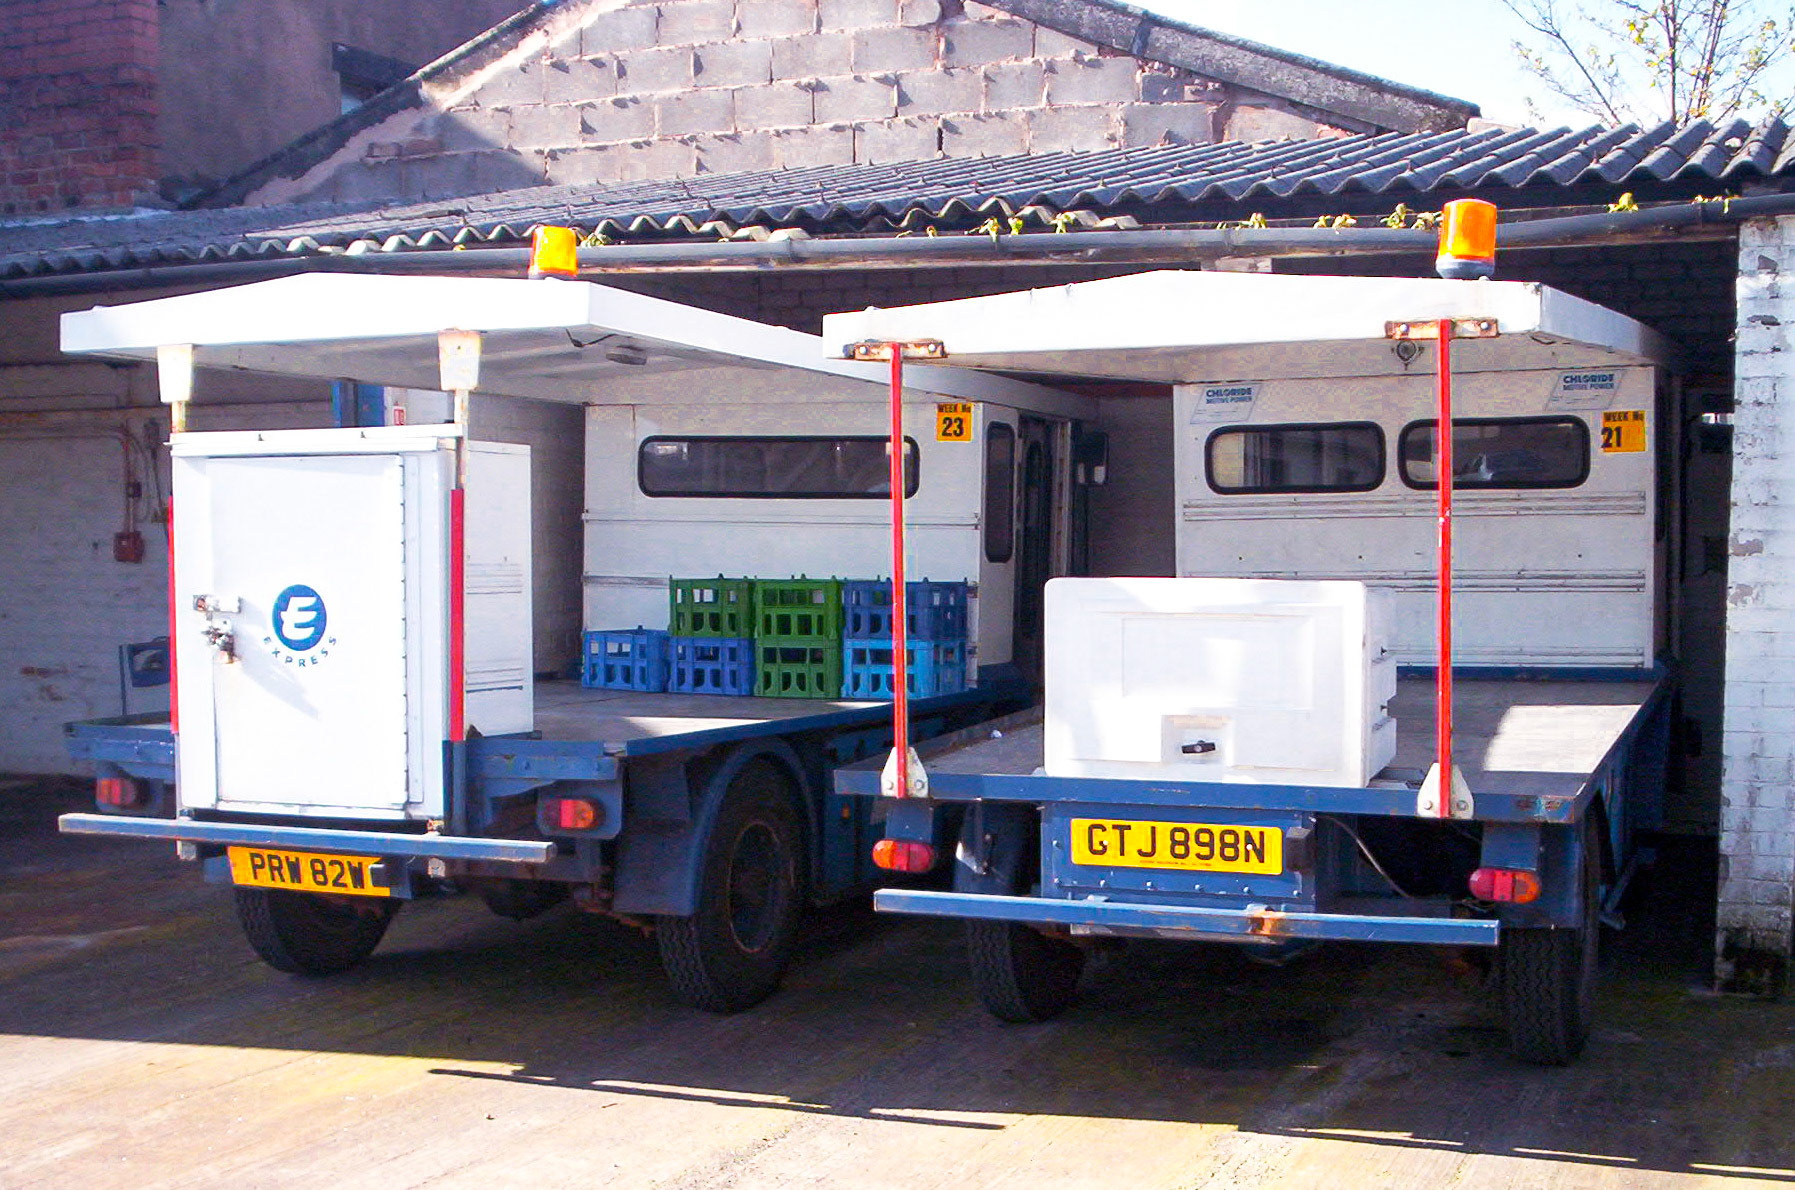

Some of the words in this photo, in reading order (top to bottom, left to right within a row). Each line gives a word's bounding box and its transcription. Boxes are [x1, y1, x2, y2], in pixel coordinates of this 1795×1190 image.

[1563, 374, 1614, 383] CHLORIDE
[1206, 388, 1252, 397] CHLORIDE
[937, 403, 958, 413] WEEK
[1604, 411, 1628, 421] WEEK
[942, 416, 964, 436] 23
[1601, 426, 1622, 448] 21
[263, 636, 337, 667] EXPRESS
[1087, 823, 1157, 858] GTJ
[1169, 827, 1265, 864] 898N
[249, 852, 302, 884] PRW
[310, 858, 365, 889] 82W
